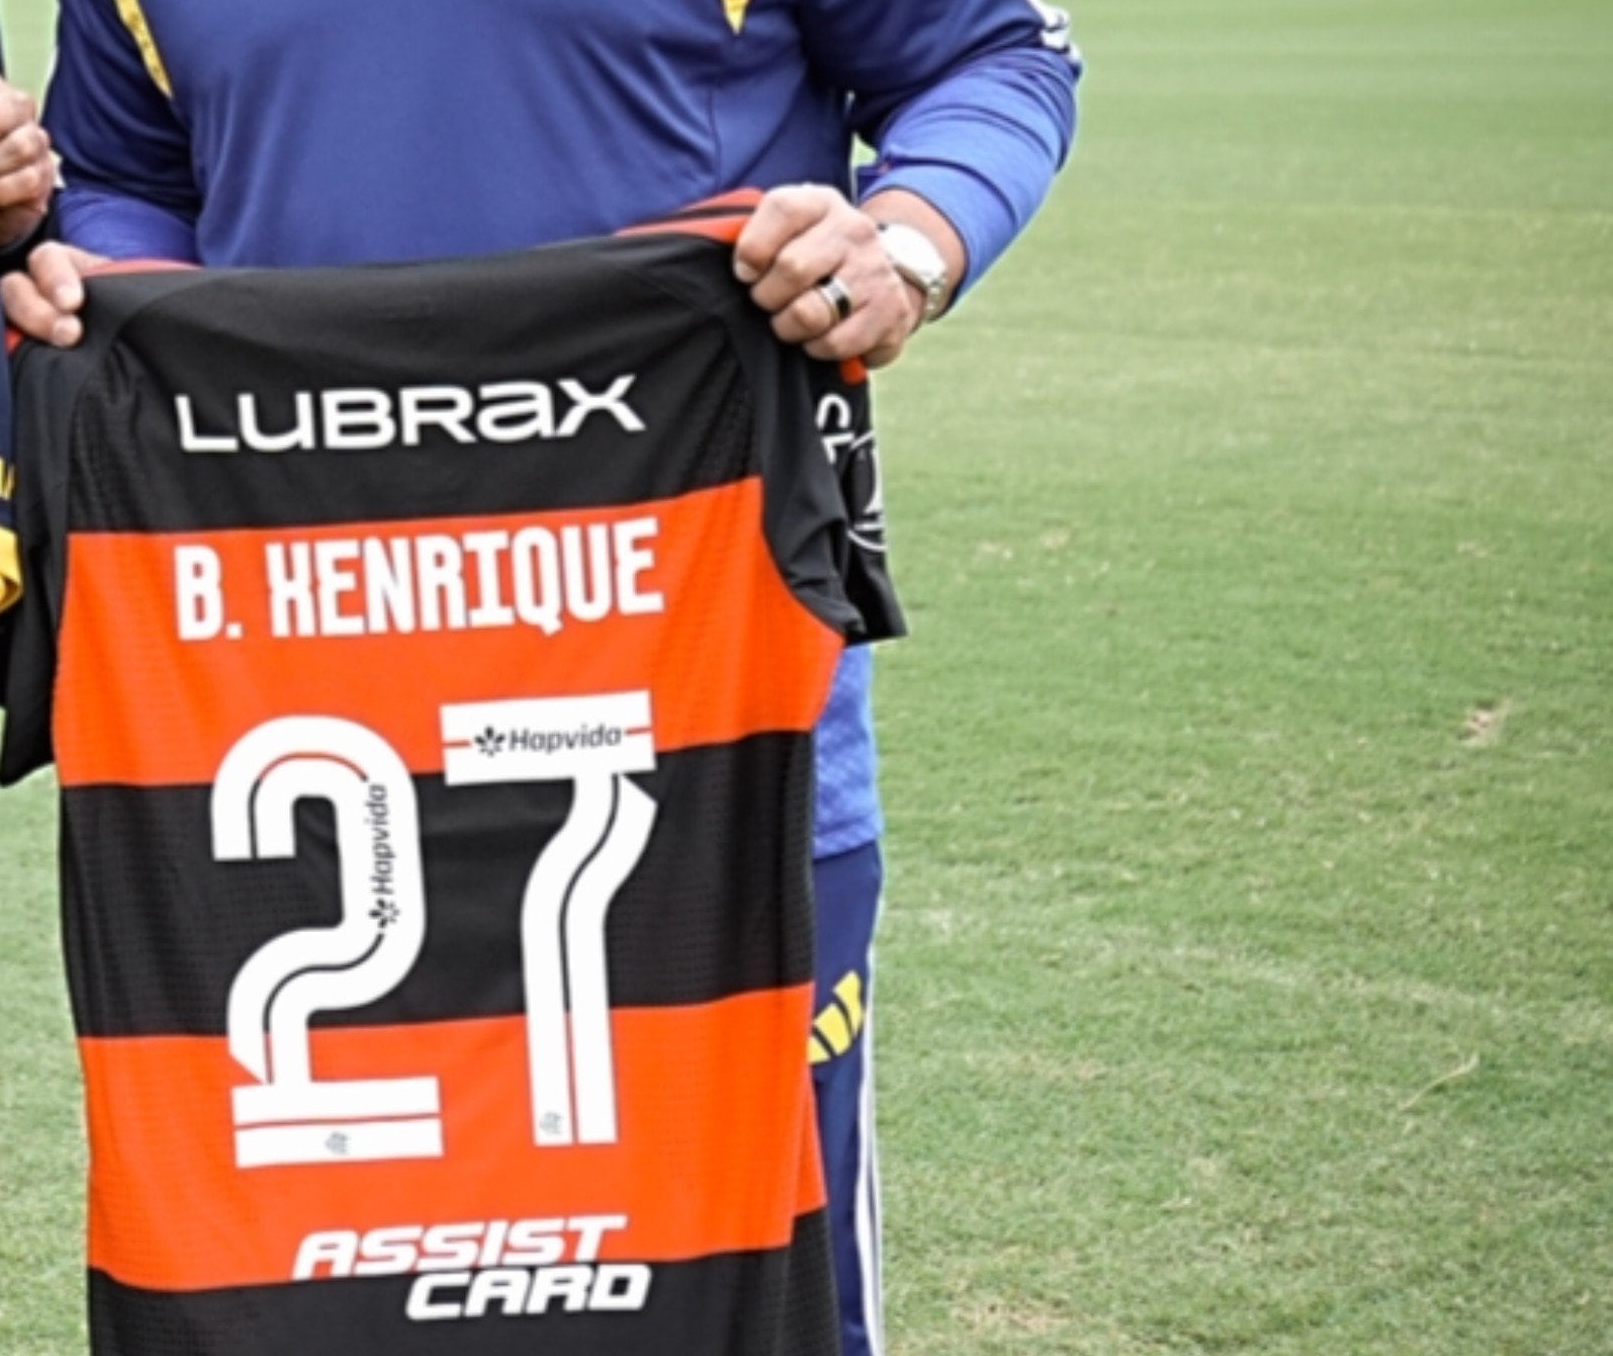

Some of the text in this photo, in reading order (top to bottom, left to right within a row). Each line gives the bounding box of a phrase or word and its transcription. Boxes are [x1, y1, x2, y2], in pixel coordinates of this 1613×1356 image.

[173, 516, 665, 641] B. HENRIQUE
[509, 723, 623, 755] Hapvida
[364, 784, 397, 895] Hapvida
[210, 689, 657, 1169] 27
[291, 1214, 628, 1282] ASSIST
[406, 1263, 652, 1321] CARD
